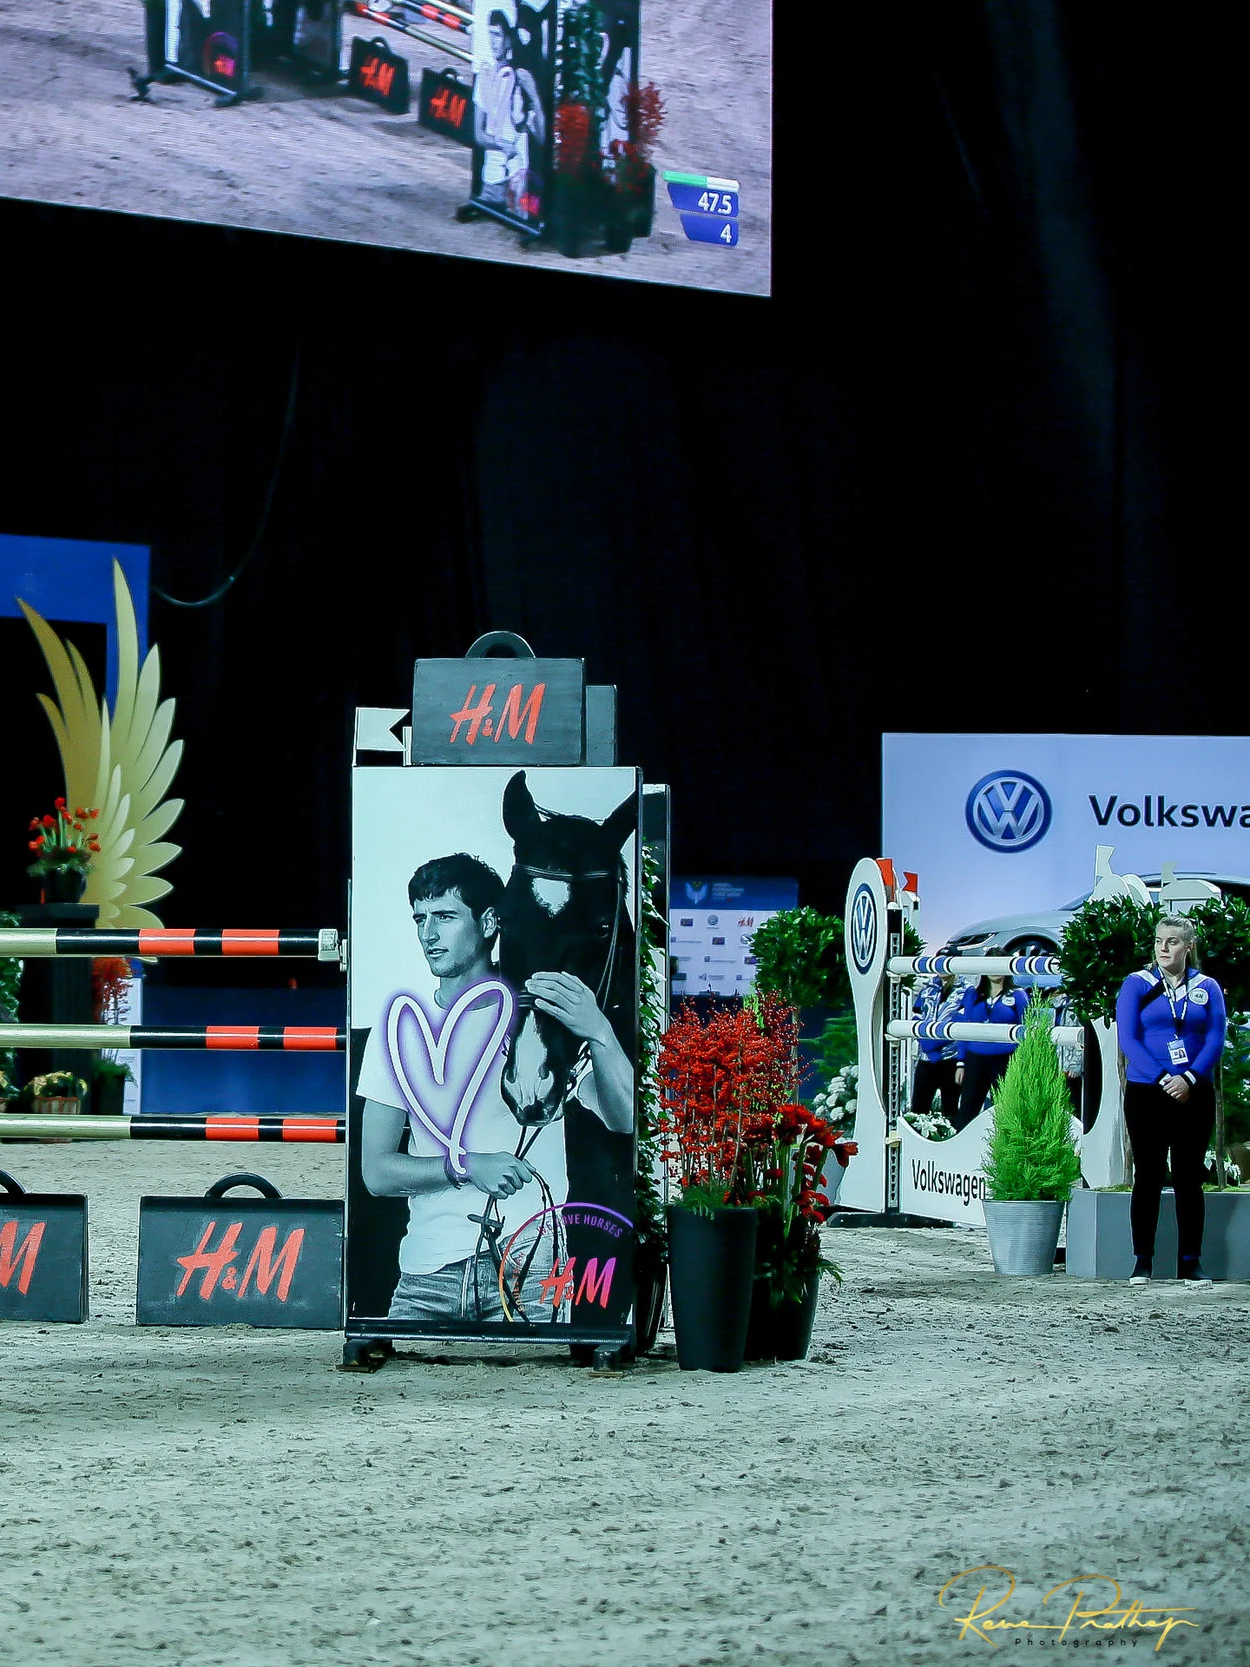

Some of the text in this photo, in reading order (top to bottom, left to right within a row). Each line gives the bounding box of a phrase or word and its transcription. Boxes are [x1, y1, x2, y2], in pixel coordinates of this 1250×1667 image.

[720, 223, 732, 243] 4
[450, 683, 546, 745] H&M
[912, 1159, 985, 1206] Volkswagen
[583, 1214, 623, 1238] HORSES
[176, 1221, 305, 1302] H&M
[539, 1256, 617, 1309] H&M
